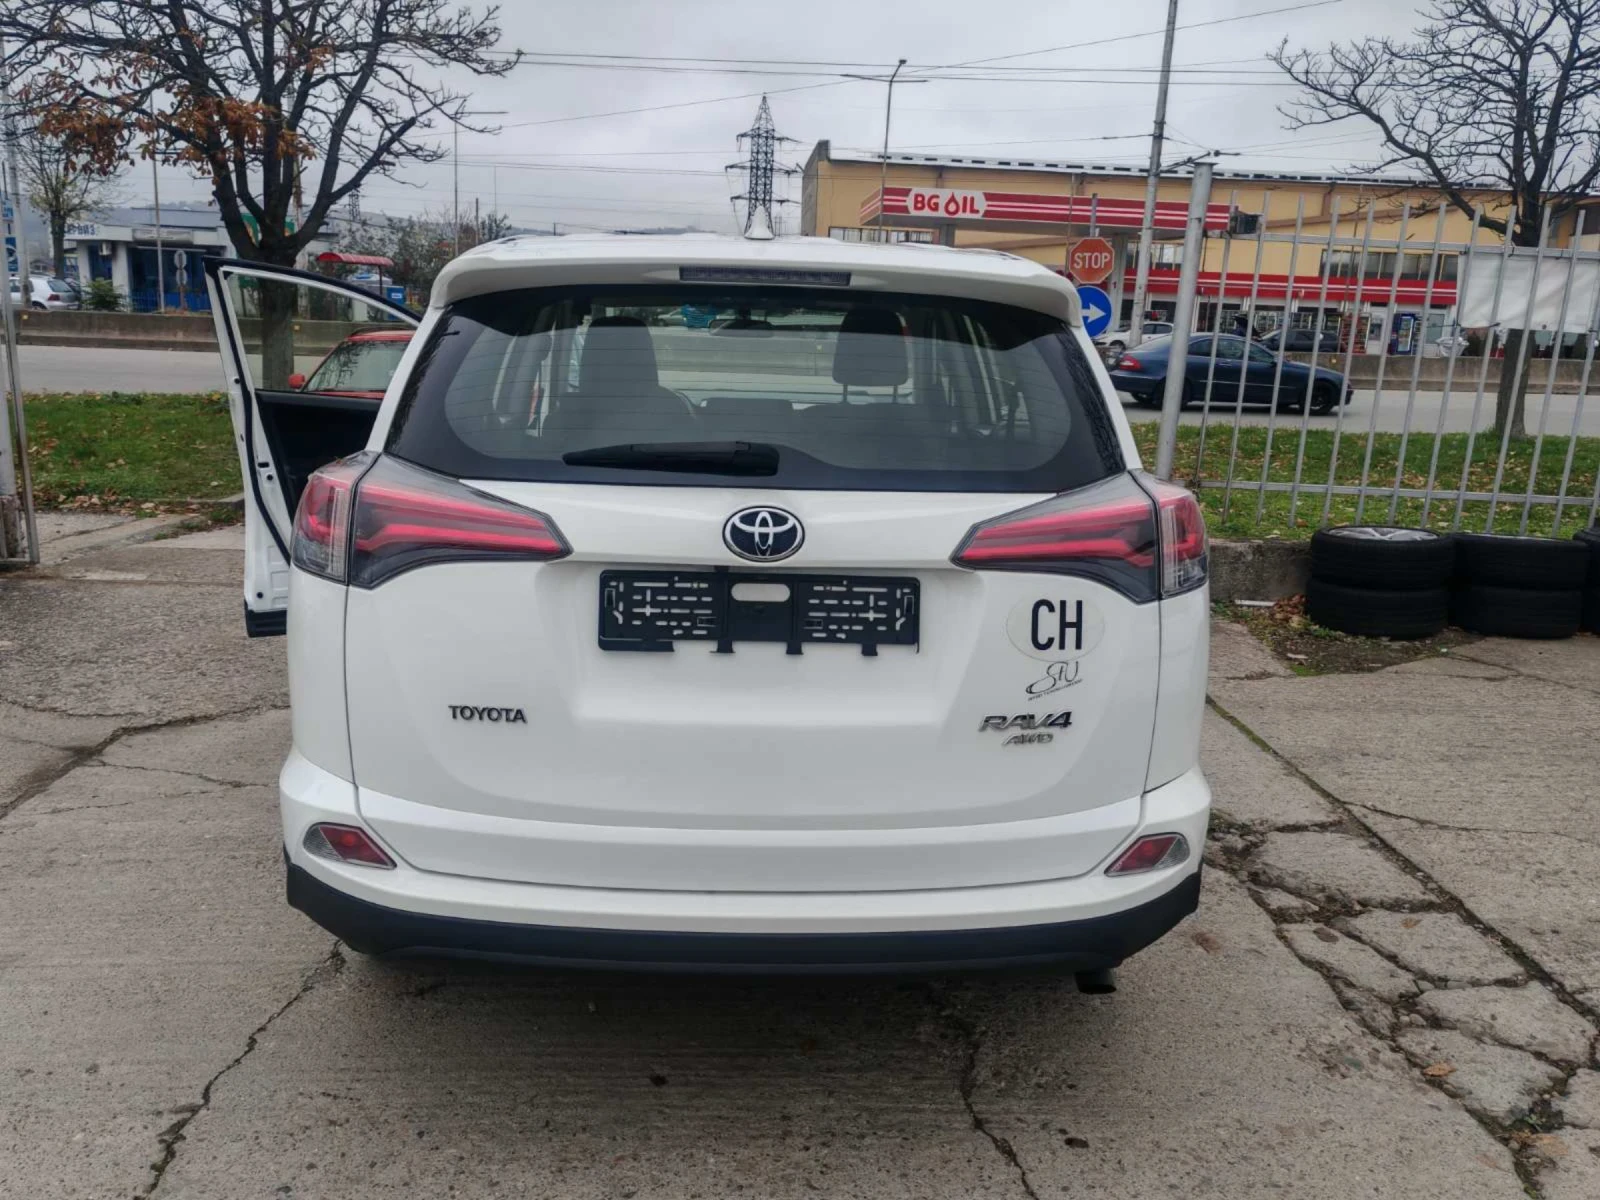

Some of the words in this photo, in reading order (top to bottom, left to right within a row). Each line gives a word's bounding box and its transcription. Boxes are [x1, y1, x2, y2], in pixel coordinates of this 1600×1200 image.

[913, 193, 940, 212] BG
[1073, 252, 1111, 269] STOP
[1031, 598, 1083, 650] CH
[448, 705, 528, 724] TOYOTA
[978, 711, 1072, 732] RAV4
[1001, 732, 1054, 746] AWD
